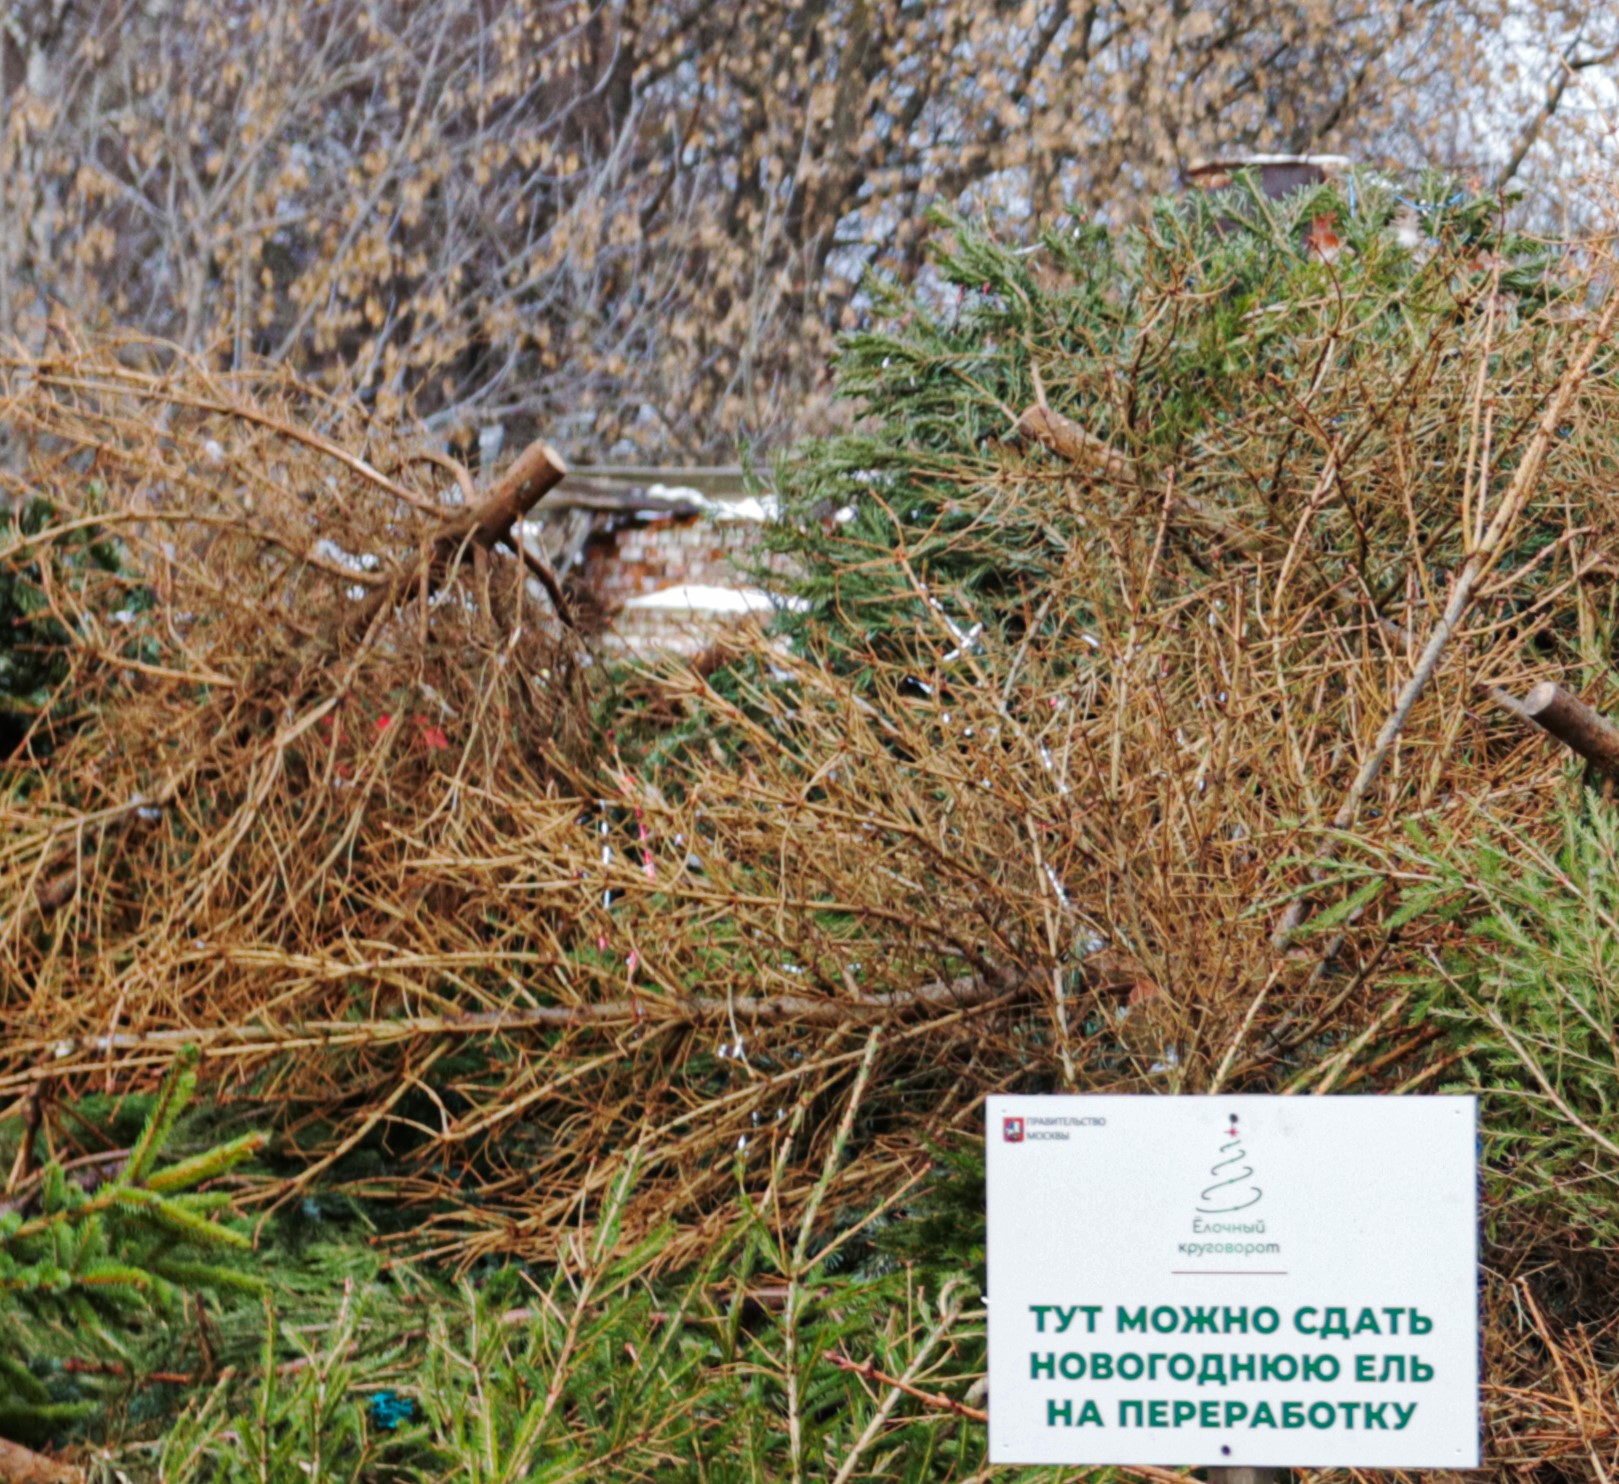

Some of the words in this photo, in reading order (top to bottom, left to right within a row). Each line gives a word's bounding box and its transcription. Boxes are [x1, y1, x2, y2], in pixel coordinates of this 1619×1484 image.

[1026, 1116, 1106, 1127] ПРАВИТЕЛЬСТВО
[1026, 1131, 1070, 1141] МОСКВЫ
[1192, 1216, 1266, 1235] Ёлочный
[1178, 1242, 1281, 1257] круговорот
[1028, 1304, 1103, 1334] ТУТ
[1116, 1305, 1281, 1335] МОЖНО
[1293, 1305, 1434, 1340] СДАТЬ
[1030, 1351, 1341, 1386] НОВОГОДНЮЮ
[1354, 1354, 1435, 1383] ЕЛЬ
[1046, 1398, 1105, 1428] НА
[1118, 1399, 1418, 1431] ПЕРЕРАБОТКУ
